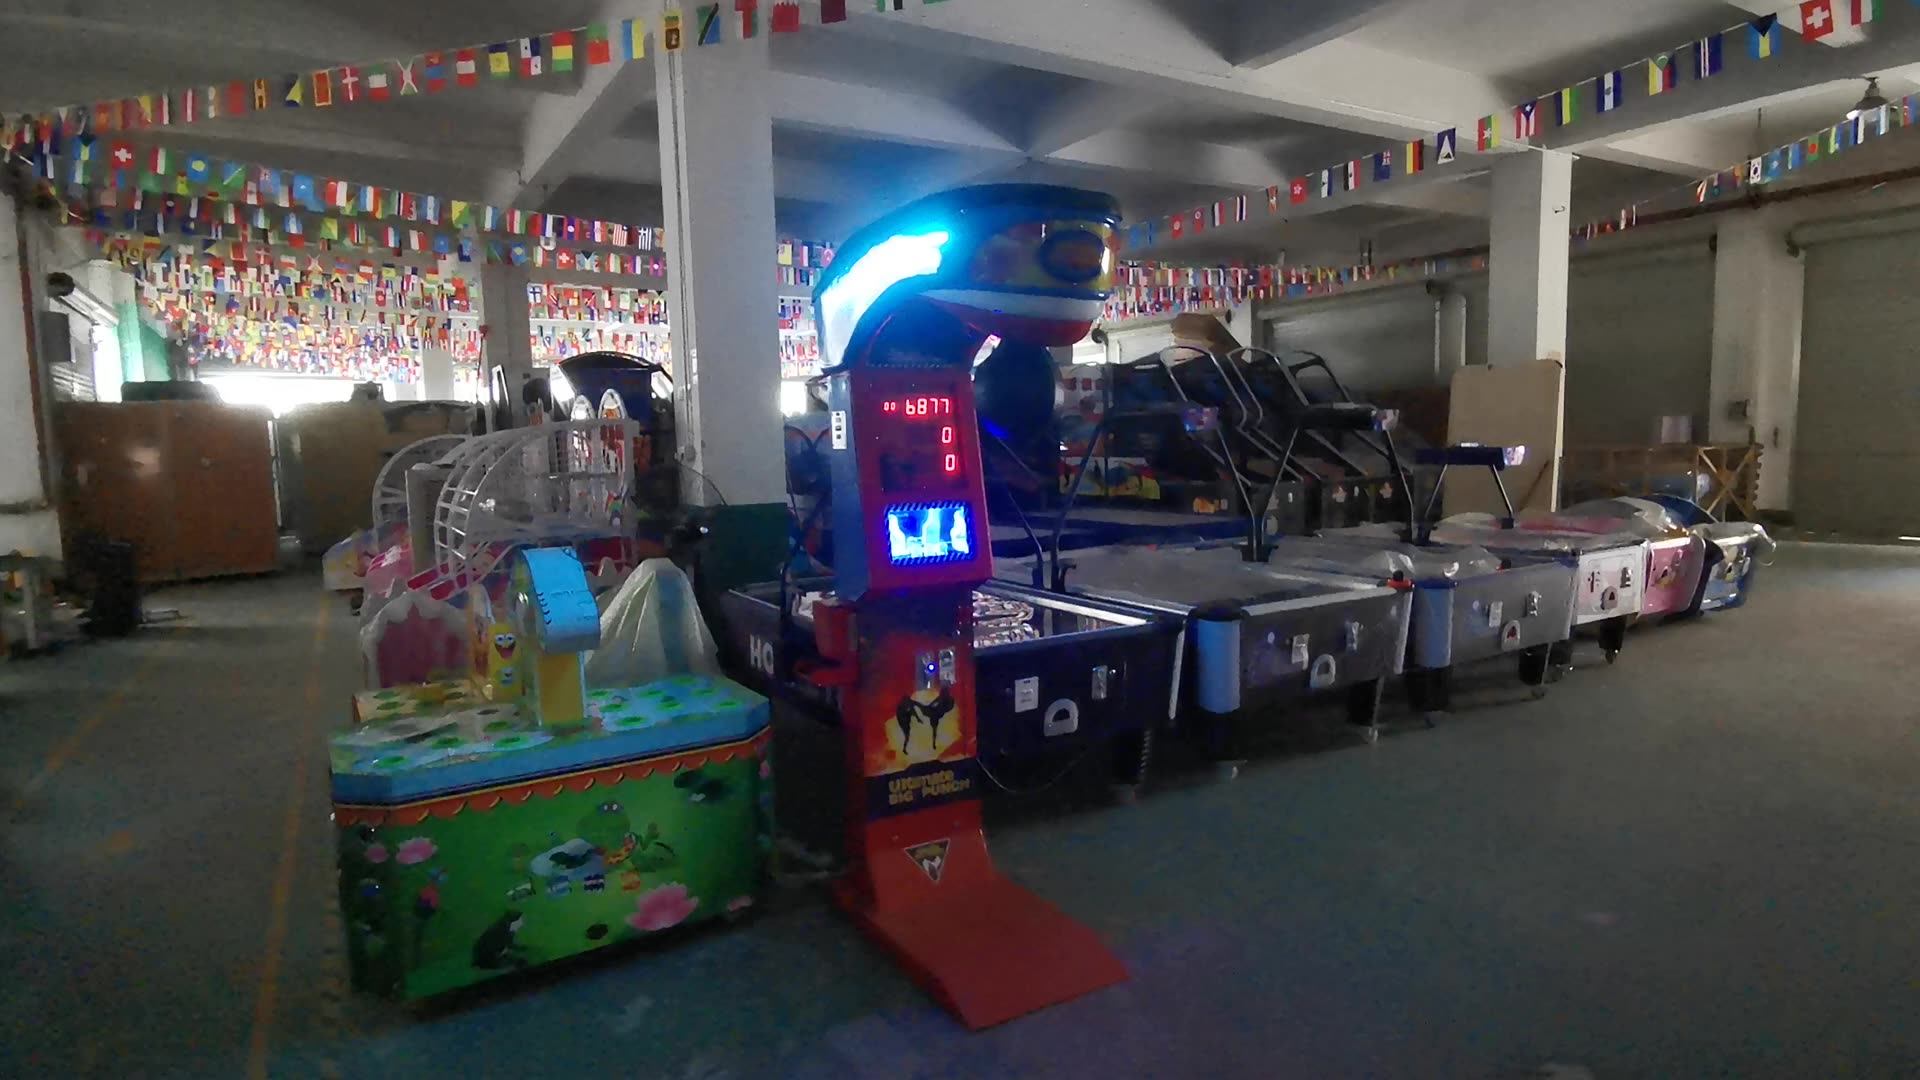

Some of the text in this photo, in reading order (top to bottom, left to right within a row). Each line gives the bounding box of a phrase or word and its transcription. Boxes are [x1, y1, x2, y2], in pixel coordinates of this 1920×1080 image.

[905, 397, 951, 415] 6877
[941, 426, 952, 444] 0
[945, 453, 956, 471] 0
